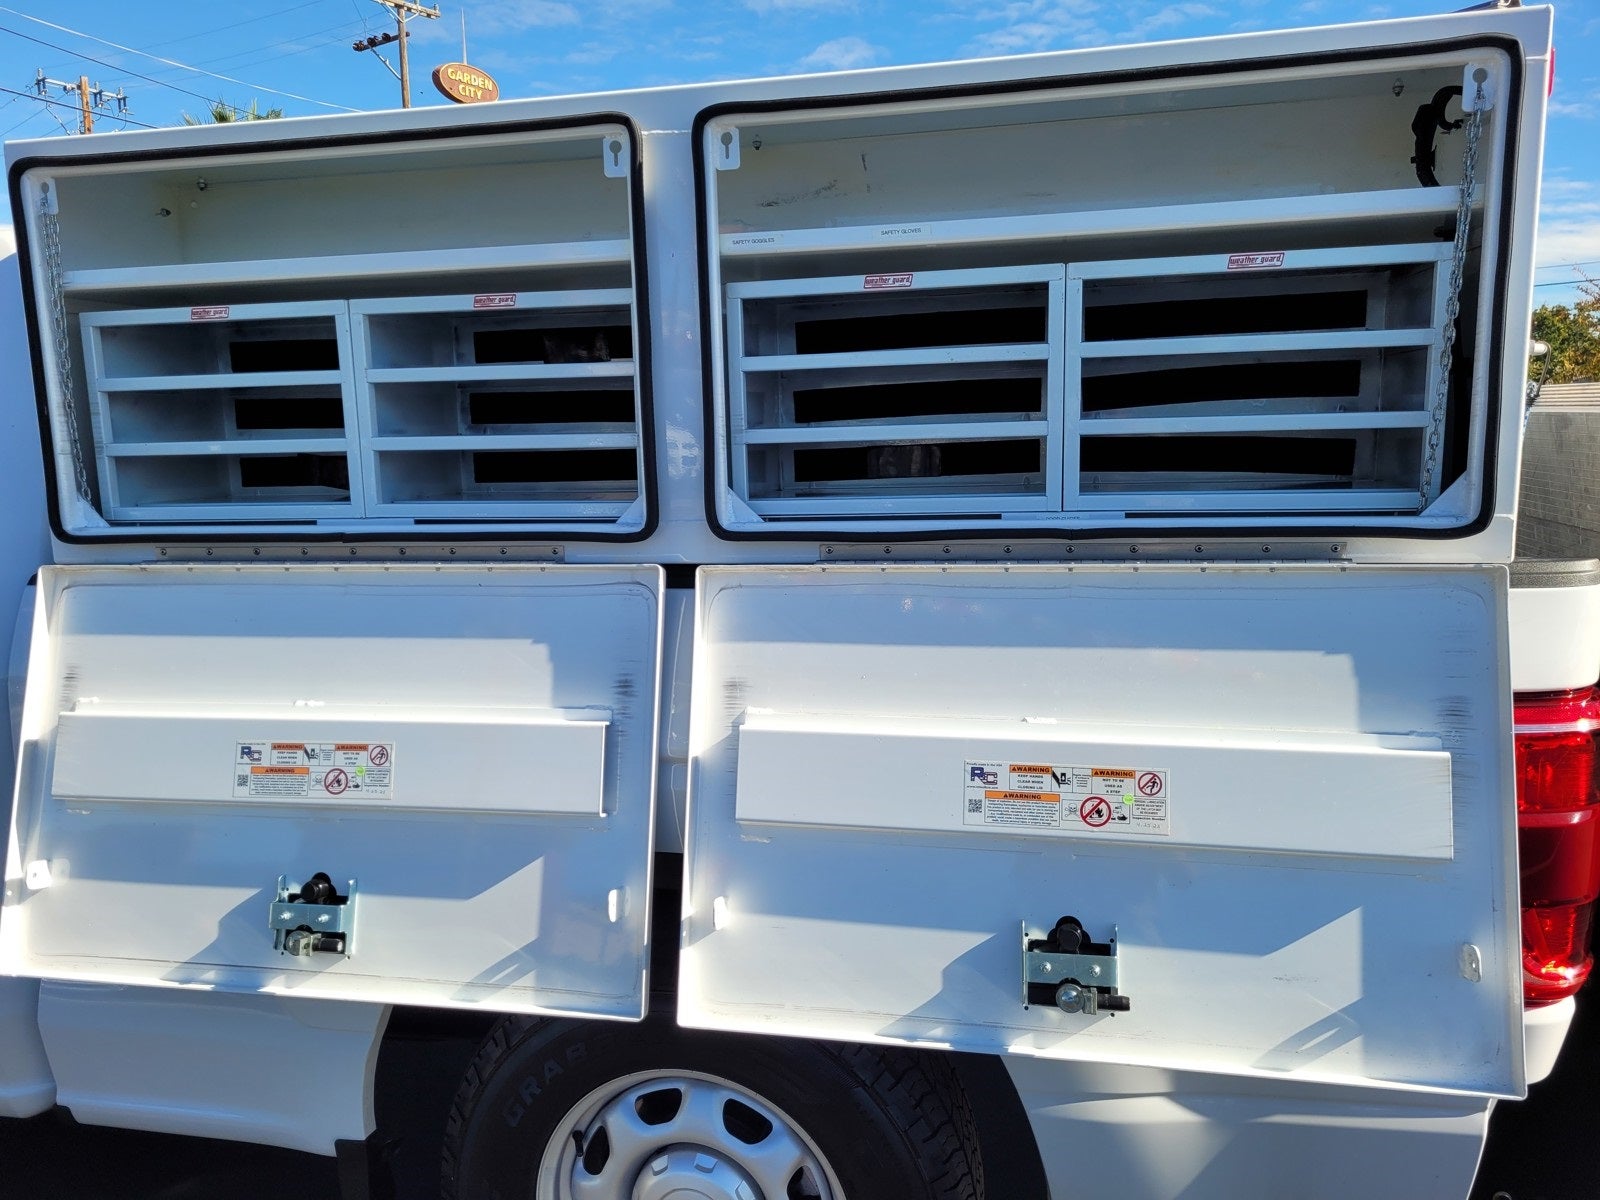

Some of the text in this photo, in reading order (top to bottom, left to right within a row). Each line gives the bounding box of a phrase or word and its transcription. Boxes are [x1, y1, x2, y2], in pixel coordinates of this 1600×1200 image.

[447, 68, 493, 91] GARDEN
[458, 84, 483, 100] CITY
[901, 227, 922, 235] GLOVES
[1230, 254, 1282, 265] weather guard
[892, 275, 911, 285] guard
